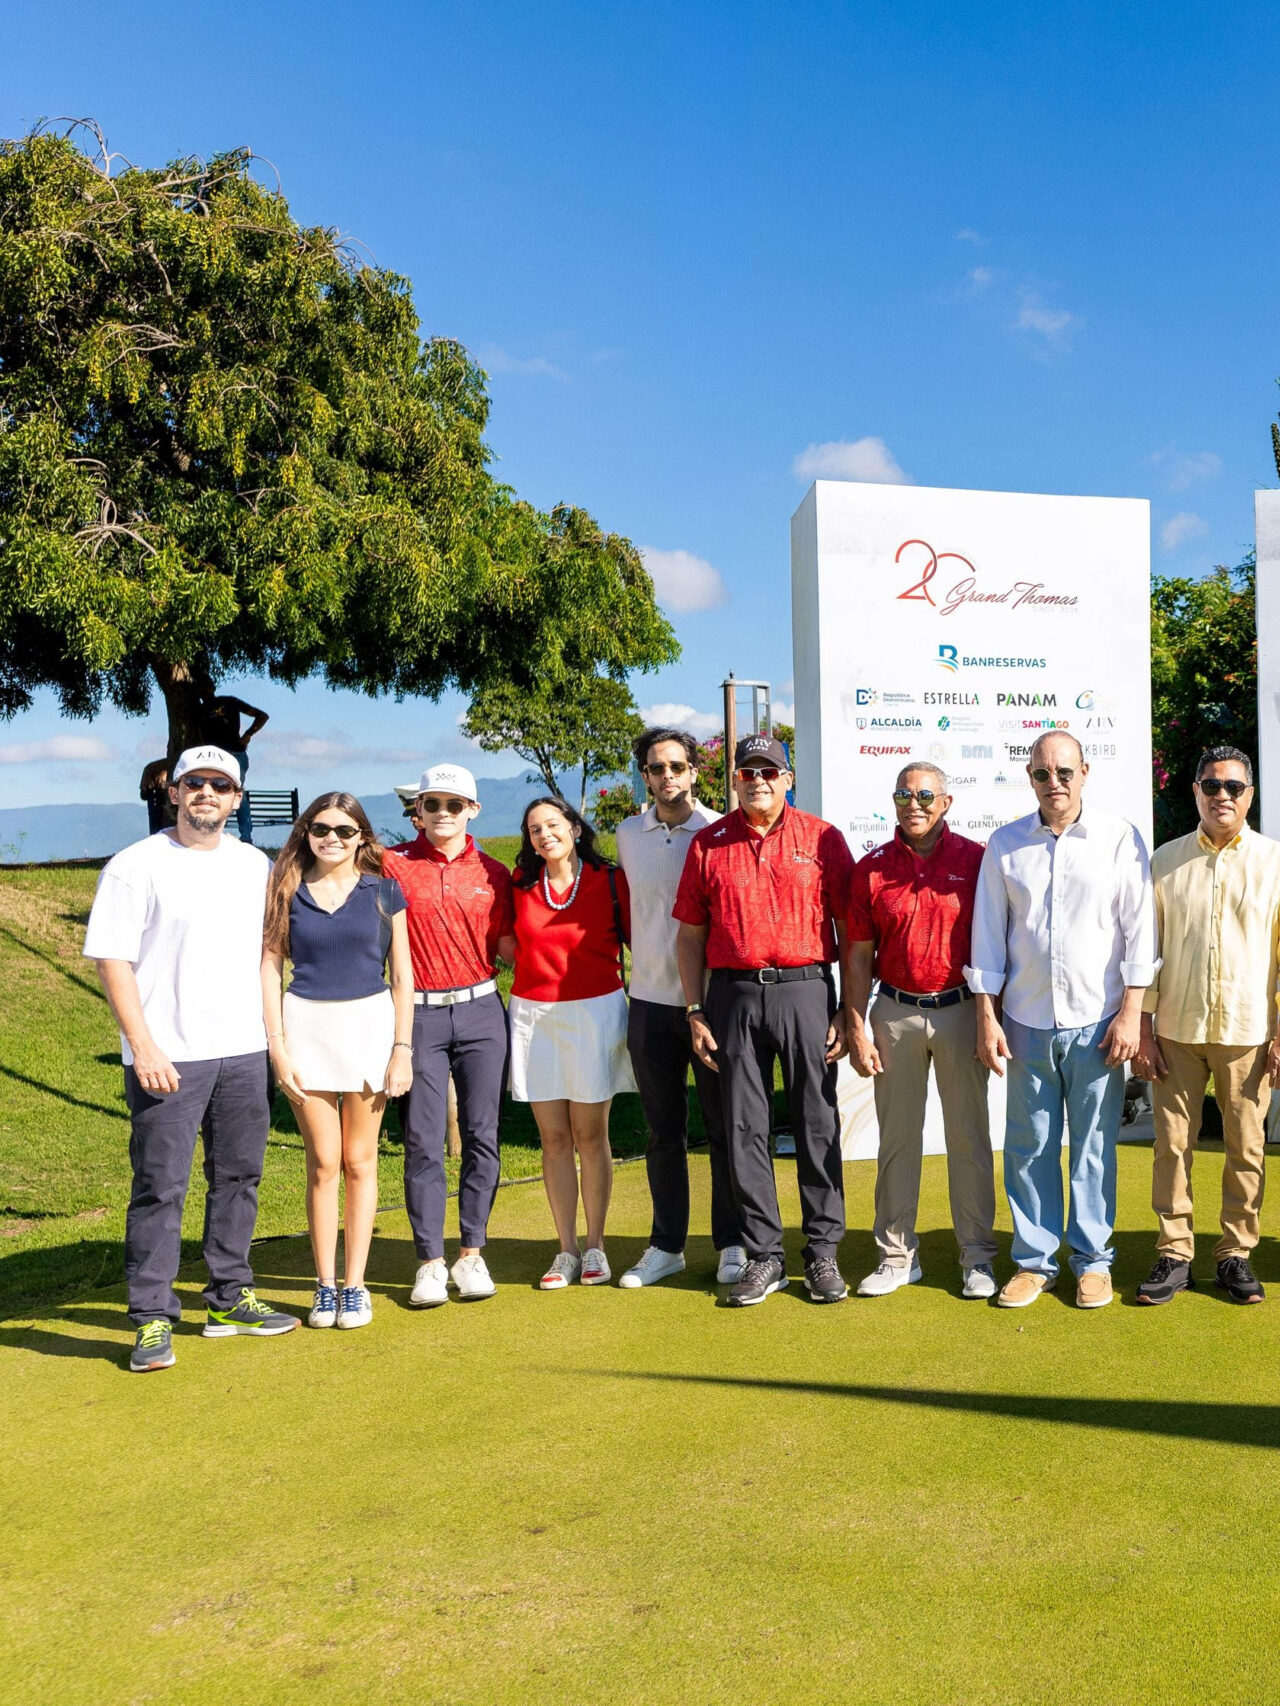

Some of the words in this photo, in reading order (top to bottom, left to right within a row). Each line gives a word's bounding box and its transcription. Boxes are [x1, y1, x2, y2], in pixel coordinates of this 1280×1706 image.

[939, 577, 1013, 616] Grand
[1012, 581, 1079, 610] Thomas
[962, 656, 1047, 668] BANRESERVAS
[924, 692, 980, 705] ESTRELLA
[996, 693, 1057, 707] PANAM
[870, 716, 923, 727] ALCALDÍA
[859, 745, 911, 756] EQUIFAX
